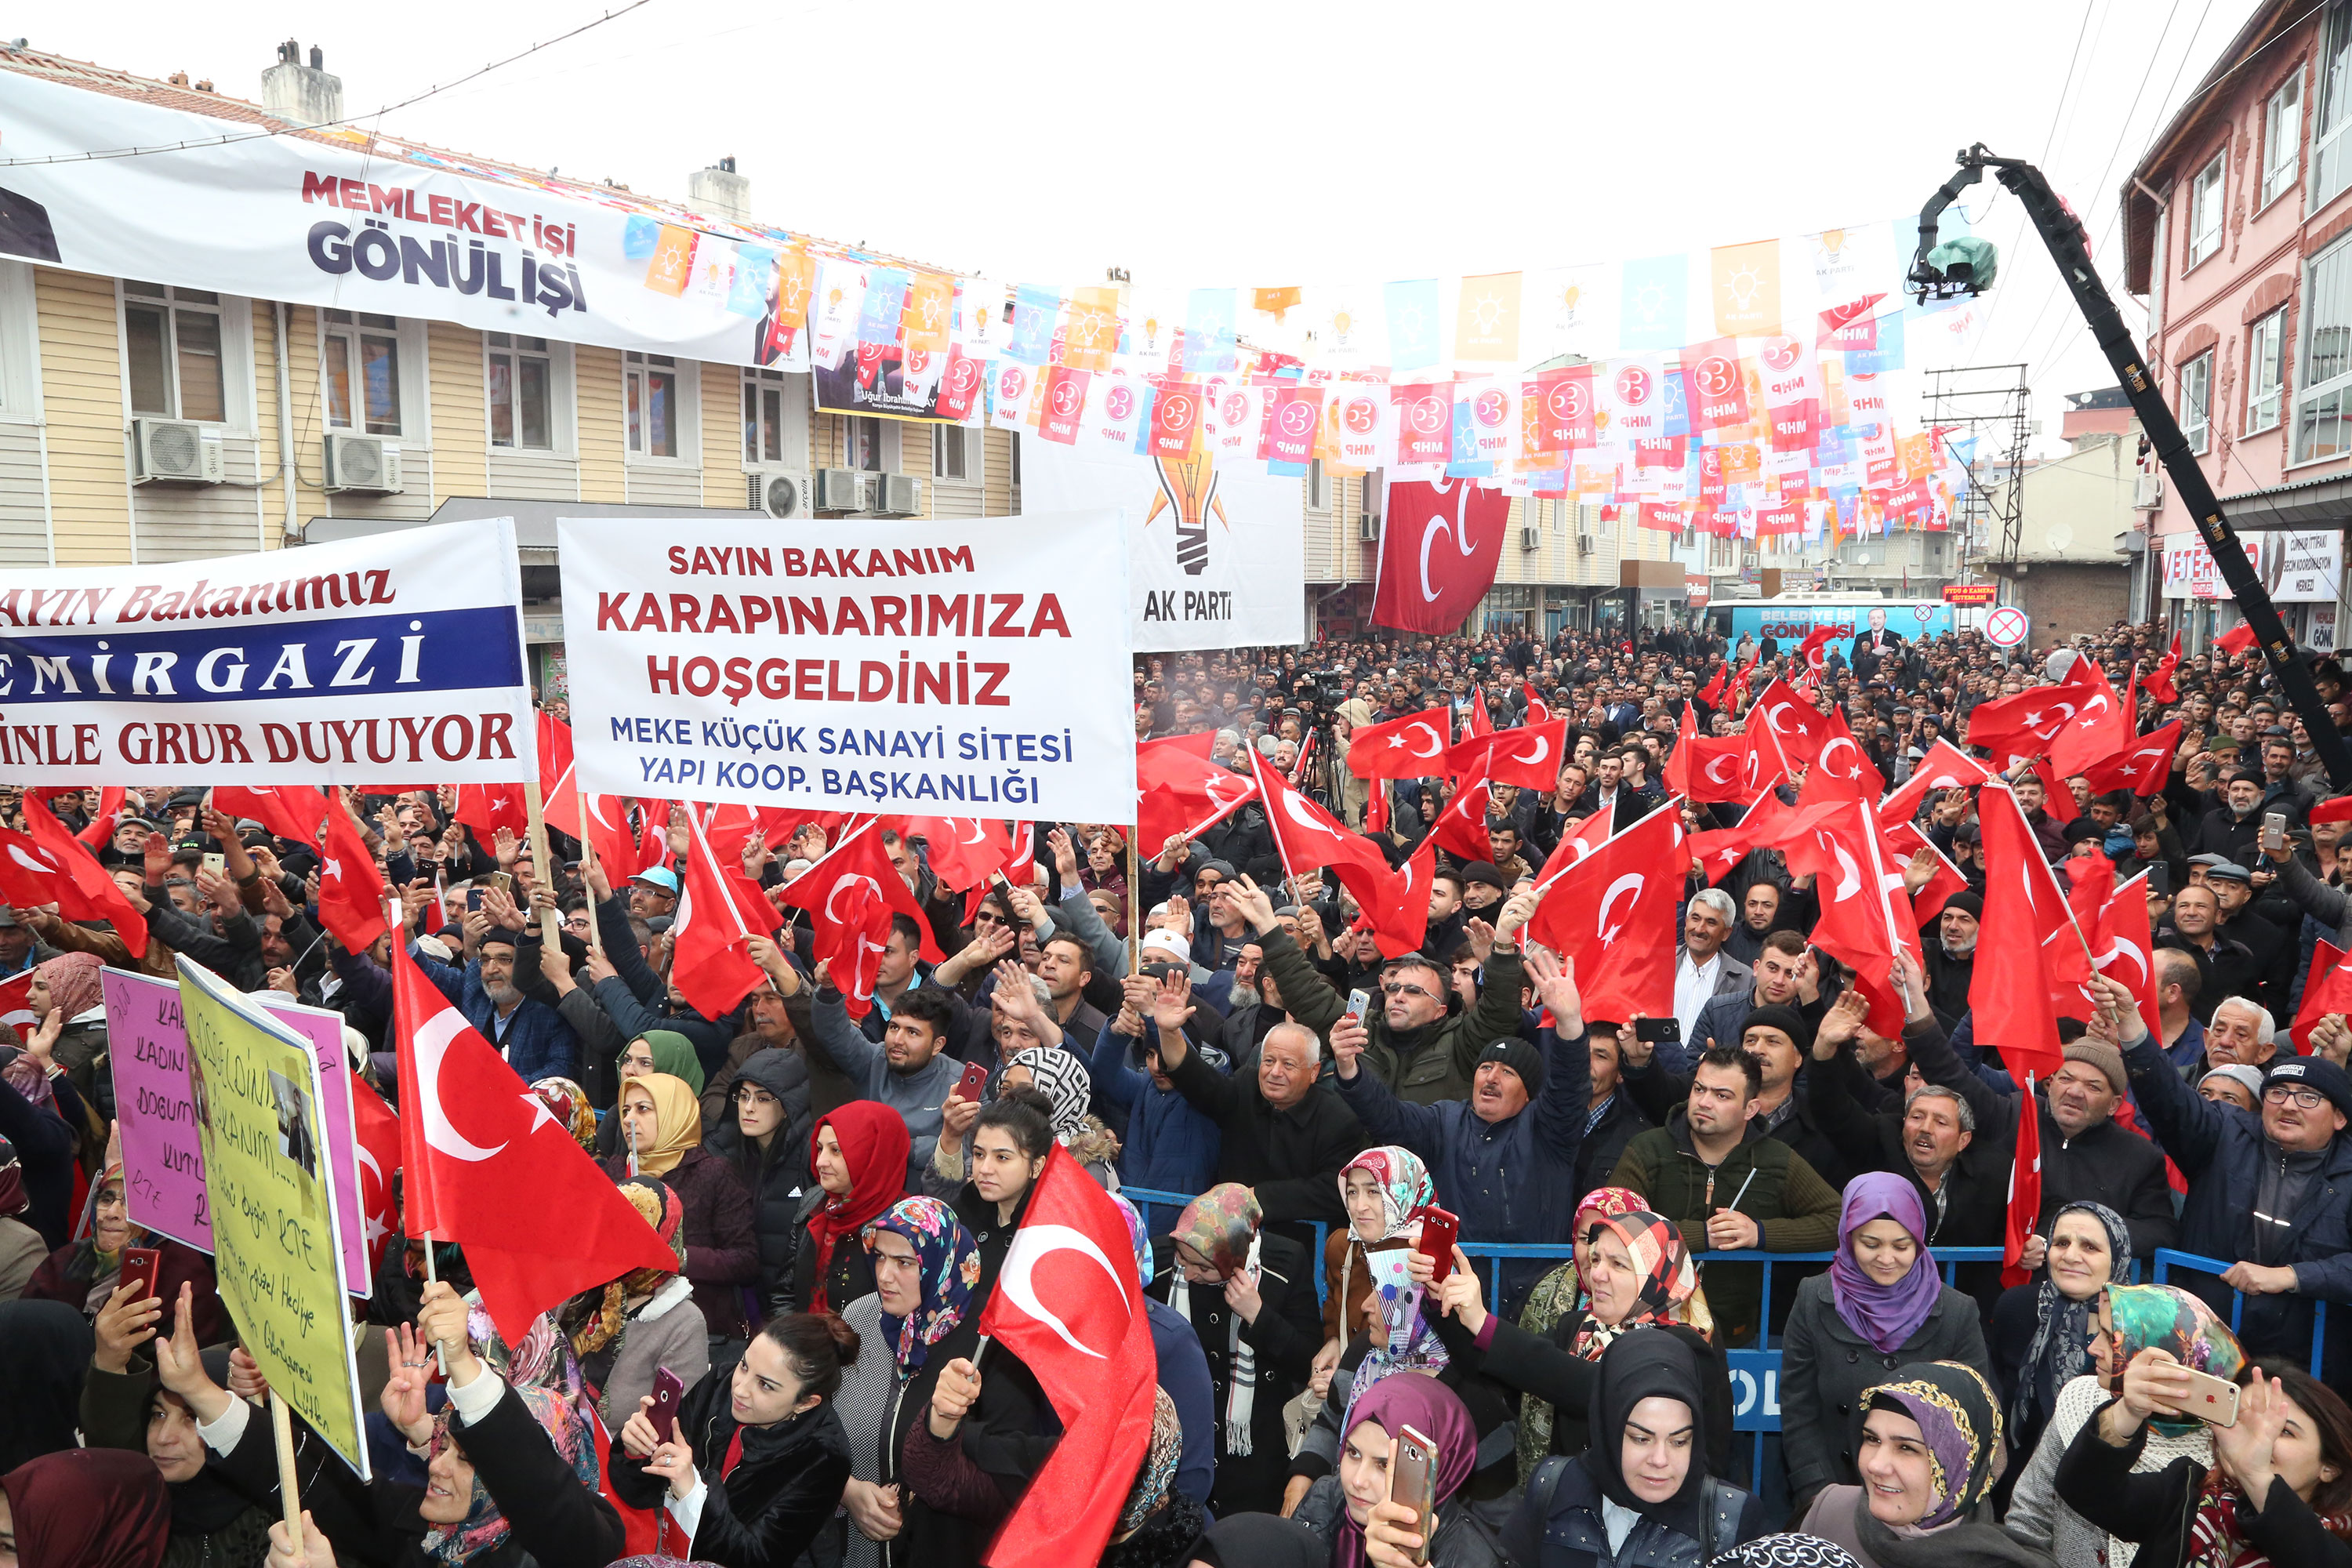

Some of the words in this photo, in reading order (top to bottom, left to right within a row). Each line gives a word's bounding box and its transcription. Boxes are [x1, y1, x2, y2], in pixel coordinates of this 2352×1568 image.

[303, 170, 528, 241] MEMLEKET
[533, 214, 576, 259] İŞİ
[307, 219, 516, 301] GÖNÜL
[521, 249, 588, 318] İŞİ
[862, 390, 881, 403] Uğur
[1663, 483, 1684, 492] MHP
[1781, 479, 1805, 490] MHP
[1870, 460, 1892, 474] MHP
[1703, 485, 1725, 495] MHP
[668, 545, 773, 577] SAYIN
[782, 543, 975, 579] BAKANIM
[114, 568, 397, 625] Bakanımız
[596, 591, 1073, 639] KARAPINARIMIZA
[1143, 590, 1177, 622] AK
[1761, 608, 1834, 622] BELEDİYE
[1837, 607, 1857, 624] İŞİ
[646, 649, 1012, 708] HOŞGELDİNİZ
[118, 721, 255, 766] GRUR
[258, 712, 517, 766] DUYUYOR
[610, 716, 691, 746] MEKE
[701, 717, 809, 756] KÜÇÜK
[818, 724, 946, 760] SANAYİ
[958, 726, 1074, 764] SİTESİ
[639, 756, 706, 786] YAPI
[716, 761, 812, 794] KOOP.
[821, 767, 1040, 805] BAŞKANLIĞI
[134, 1036, 185, 1073] KADIN
[278, 1207, 317, 1272] RTE
